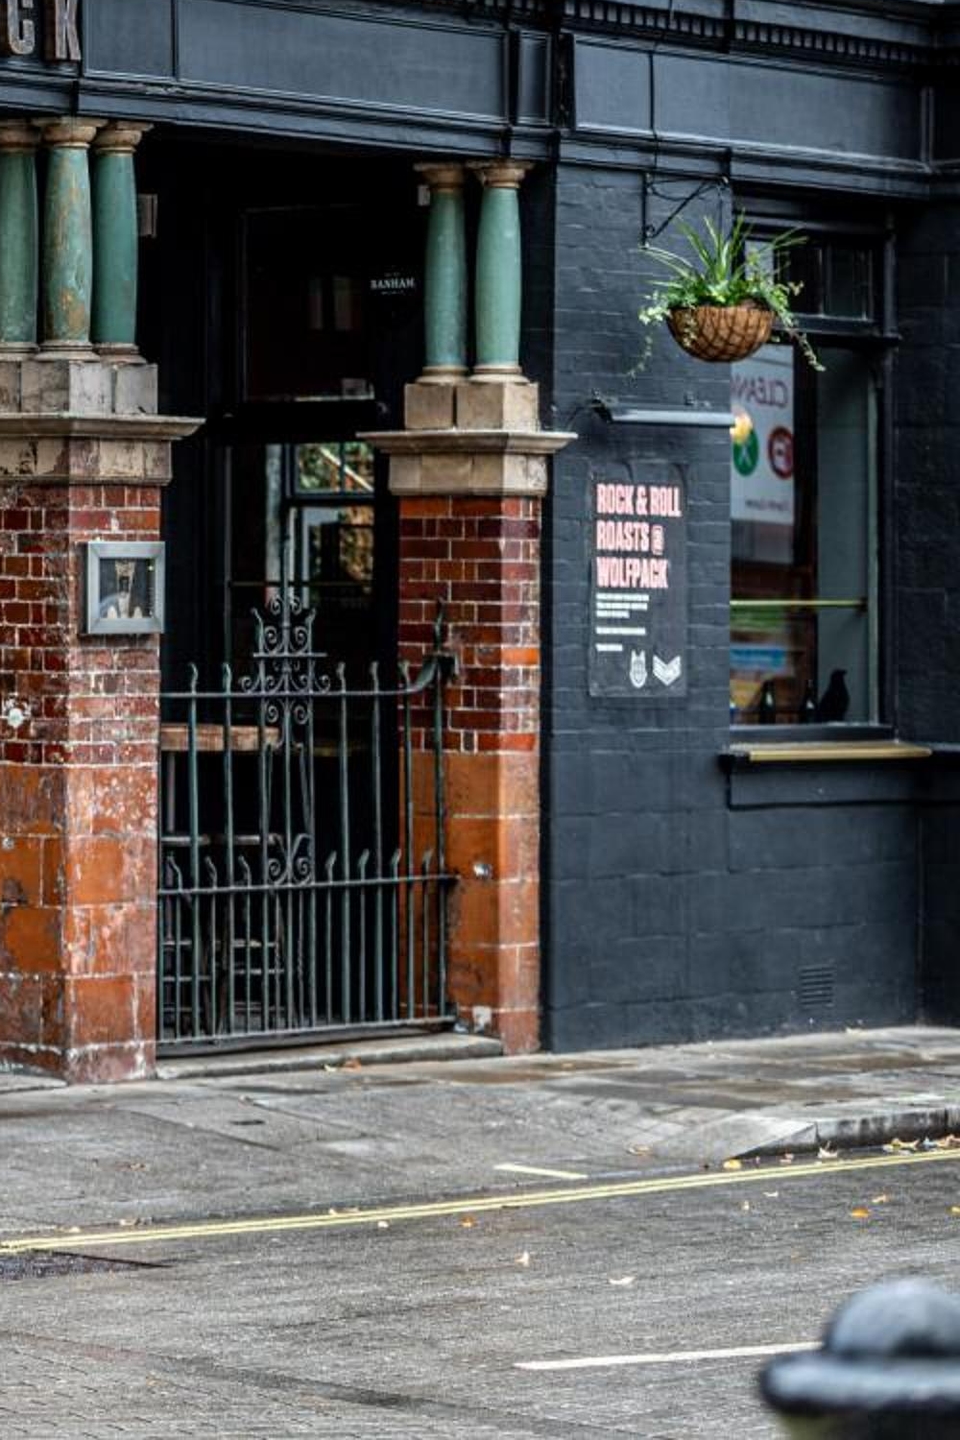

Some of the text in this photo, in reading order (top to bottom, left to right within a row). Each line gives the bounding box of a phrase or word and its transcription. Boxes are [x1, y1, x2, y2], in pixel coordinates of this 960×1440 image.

[597, 483, 682, 517] ROCK & ROLL
[597, 520, 650, 552] ROASTS
[597, 556, 669, 589] WOLFPACK
